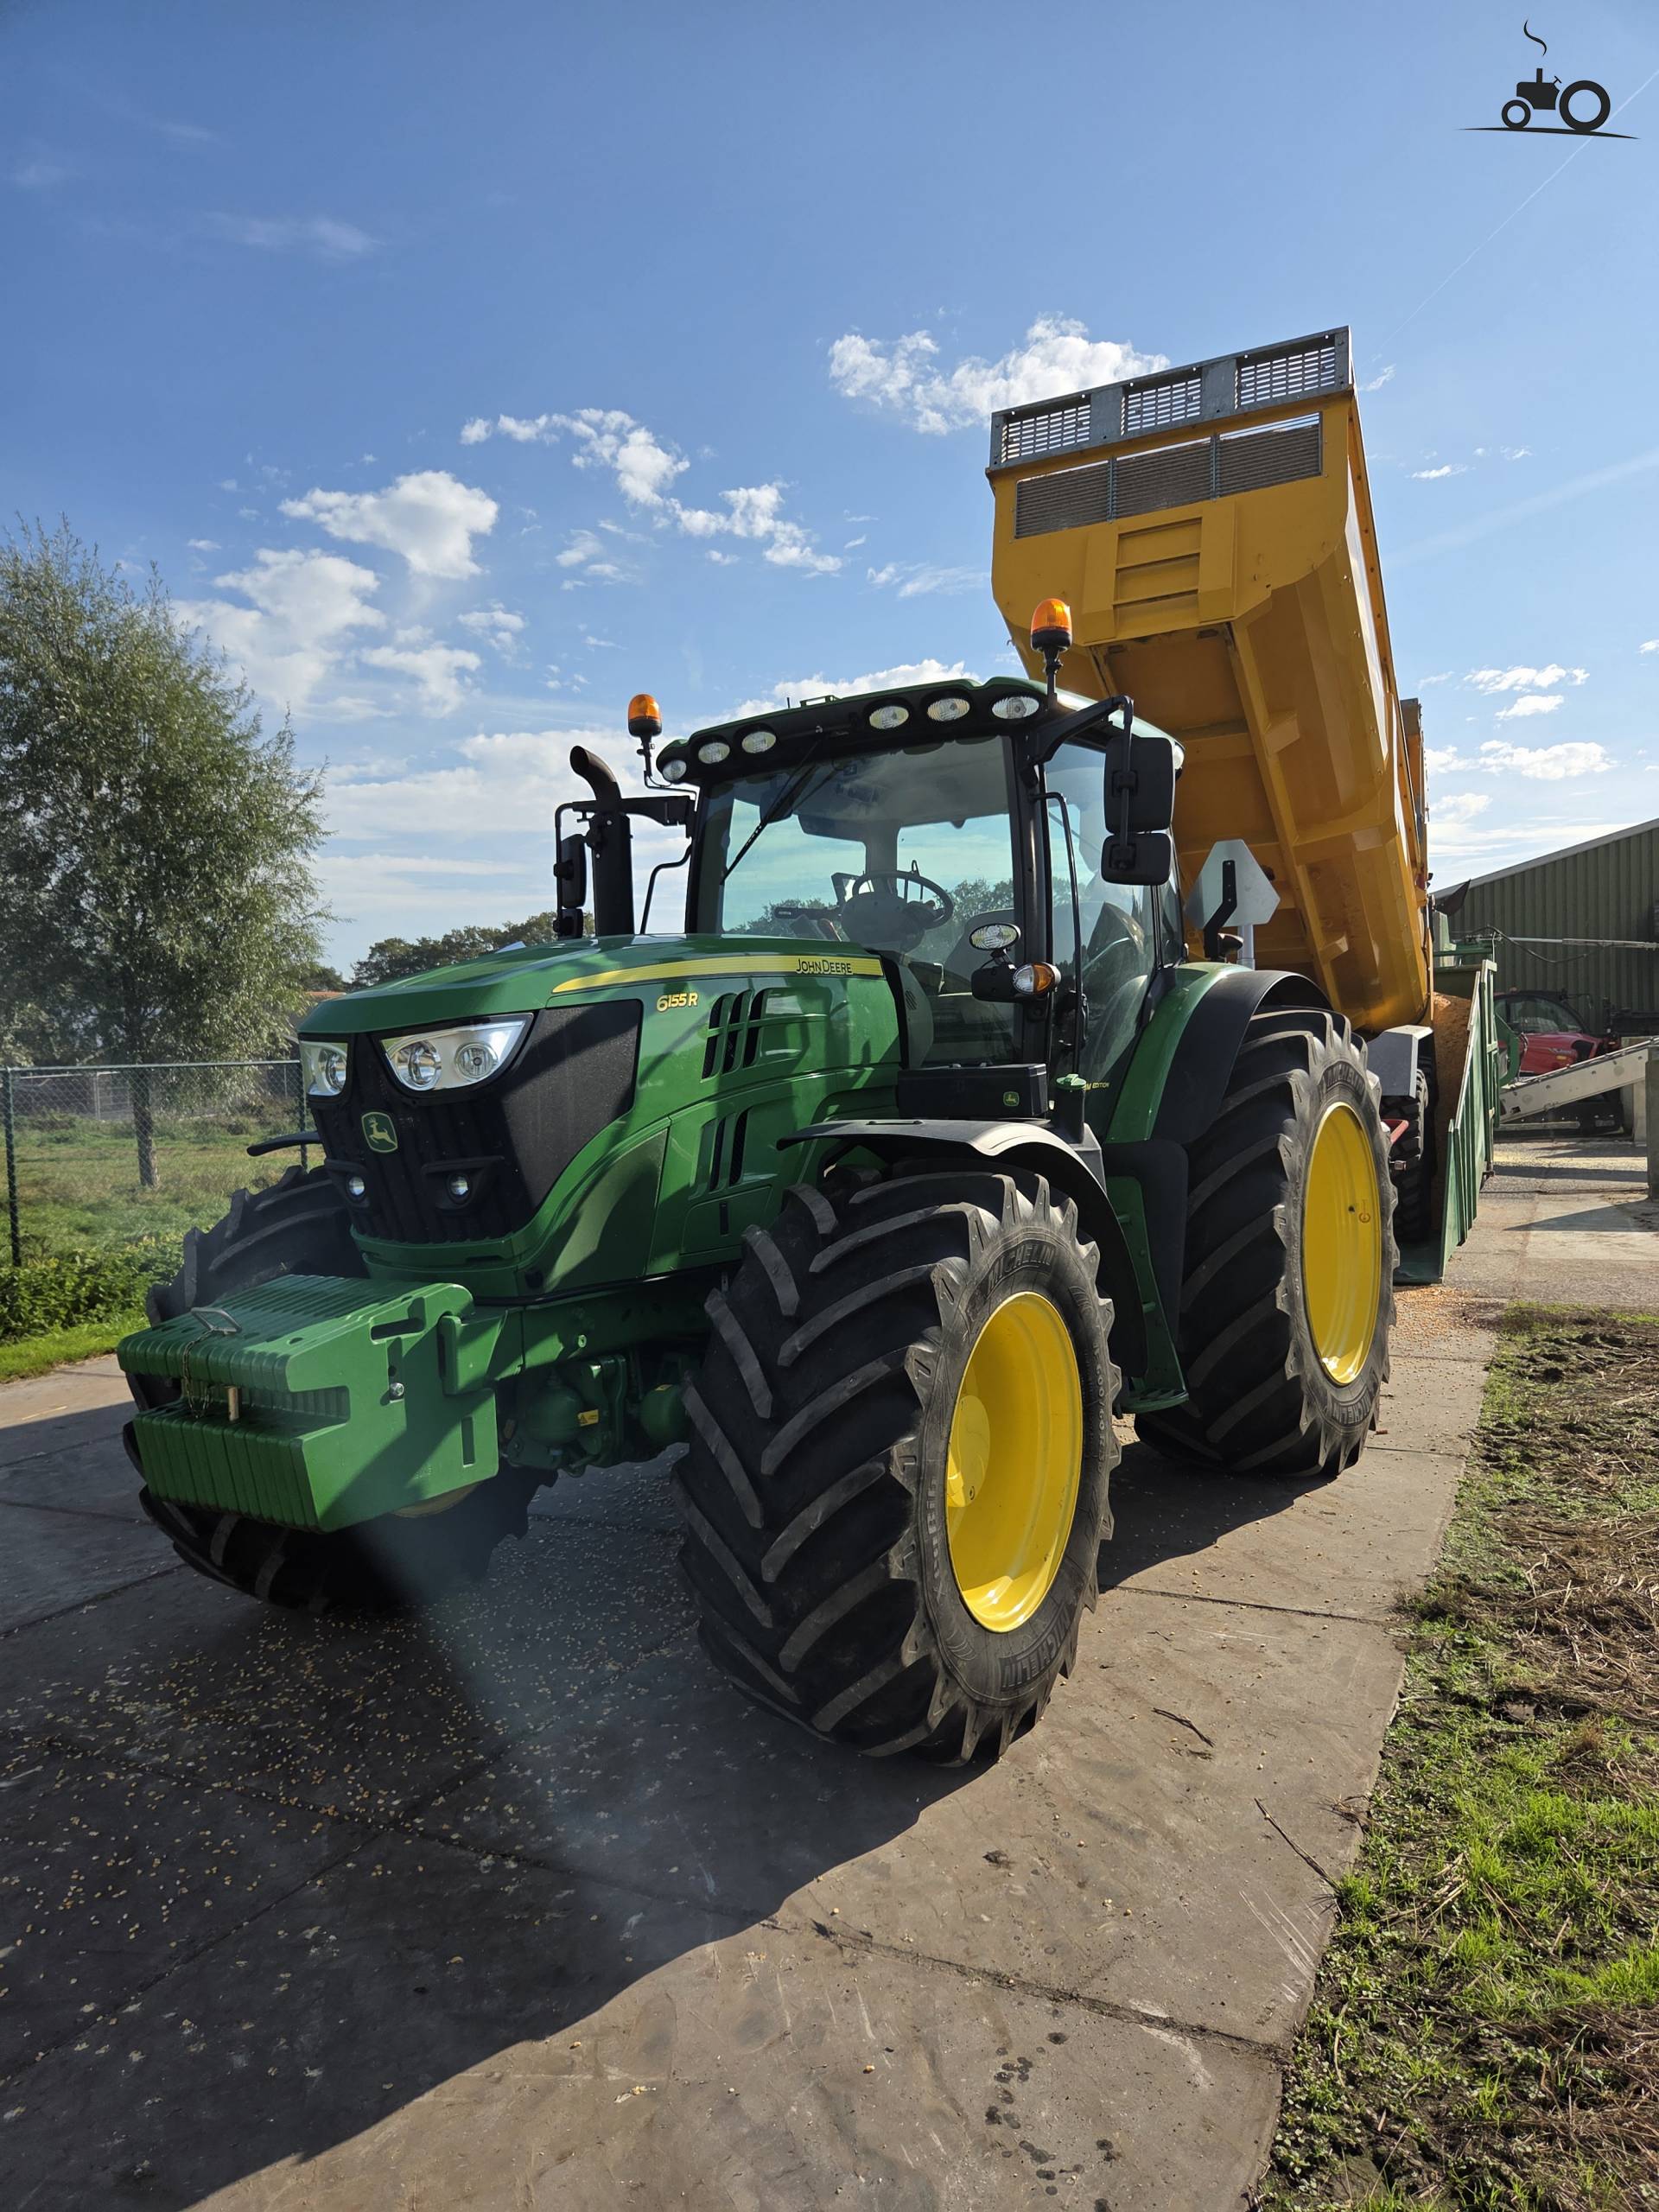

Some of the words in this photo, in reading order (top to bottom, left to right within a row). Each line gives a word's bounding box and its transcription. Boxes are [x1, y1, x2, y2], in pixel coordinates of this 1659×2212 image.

[796, 957, 821, 973] JOHN
[822, 959, 852, 975] DEERE
[987, 1243, 1055, 1294] MICHELIN
[1002, 1605, 1071, 1688] MICHELIN
